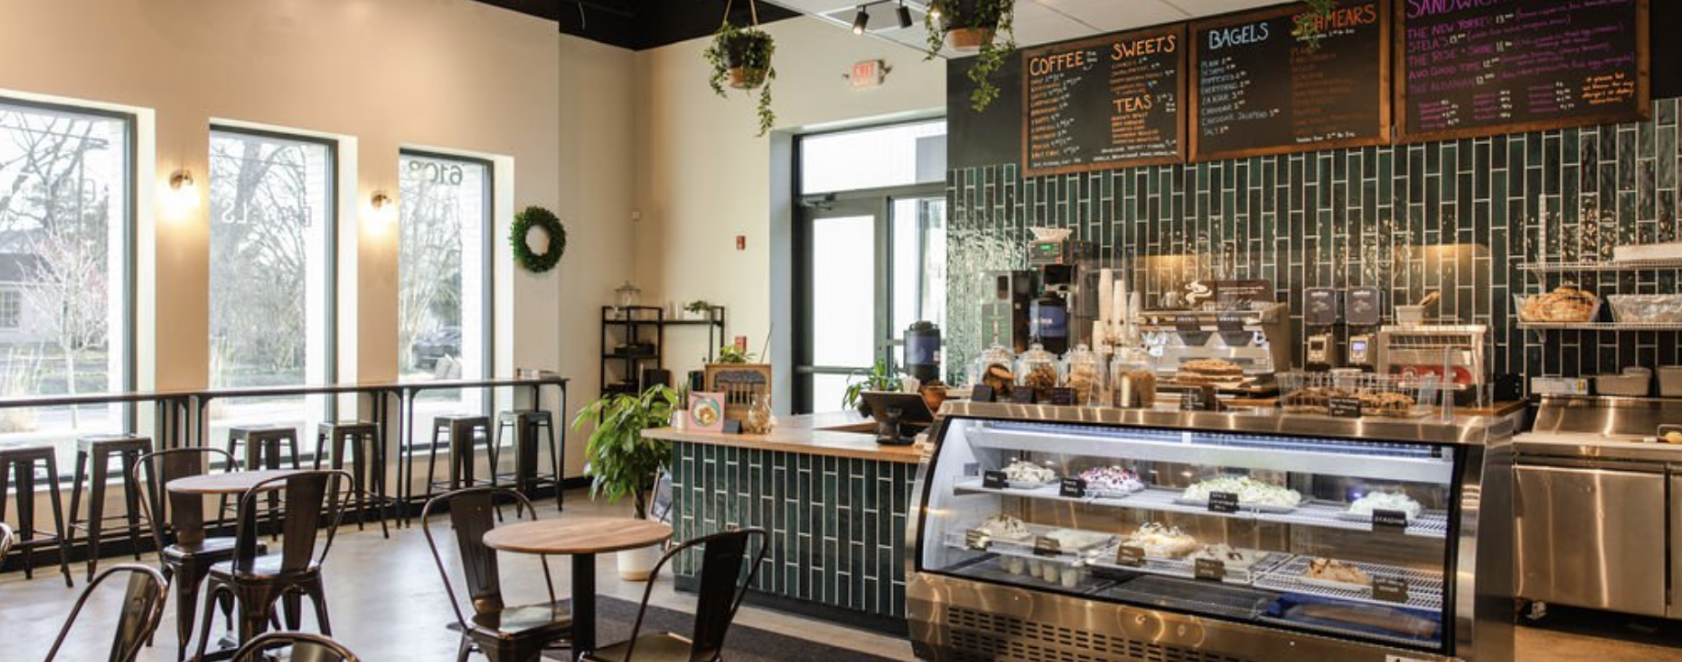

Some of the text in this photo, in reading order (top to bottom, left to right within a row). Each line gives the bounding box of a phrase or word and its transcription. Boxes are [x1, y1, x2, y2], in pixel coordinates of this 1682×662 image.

[1111, 34, 1176, 61] SWEETS
[1209, 22, 1269, 49] BAGELS
[1029, 50, 1084, 76] COFFEE
[1112, 94, 1152, 113] TEAS
